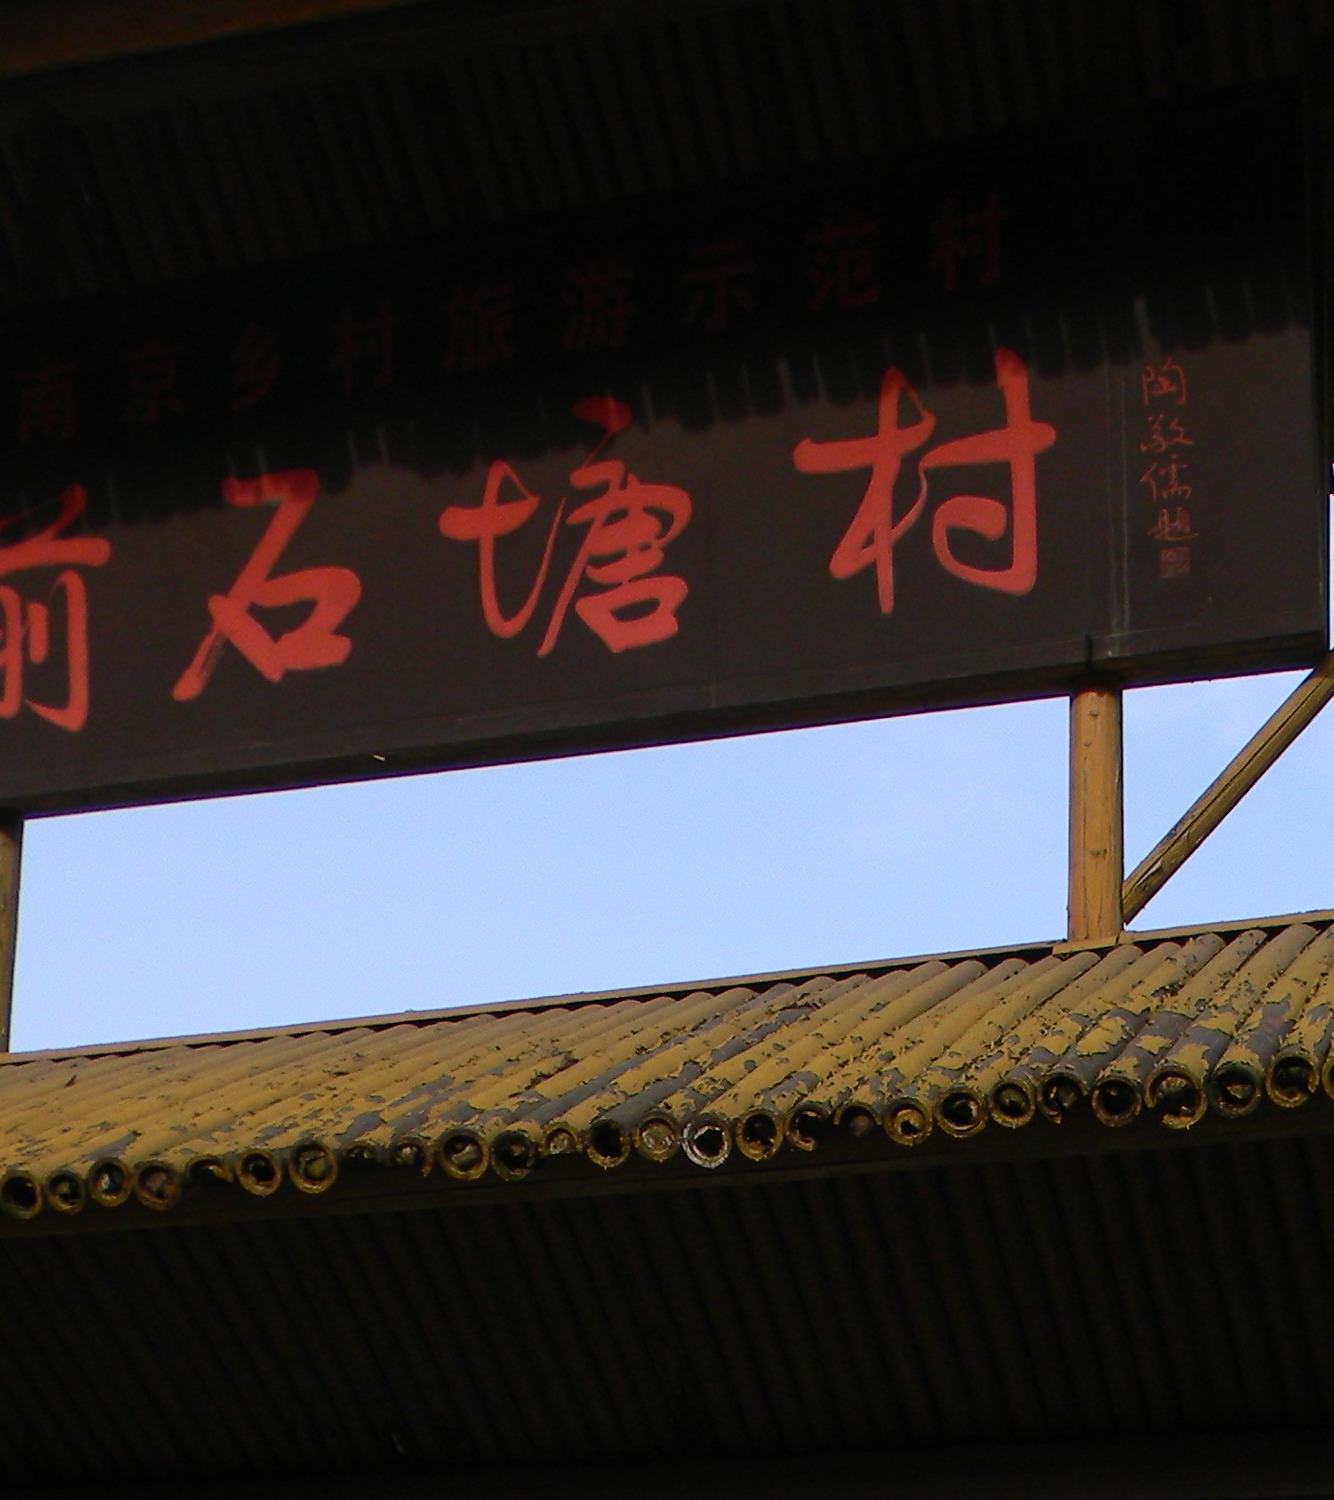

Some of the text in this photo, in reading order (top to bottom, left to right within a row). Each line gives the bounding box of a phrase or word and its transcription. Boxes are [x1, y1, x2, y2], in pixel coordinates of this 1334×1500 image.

[13, 191, 1010, 444] 南京乡村旅游示范村
